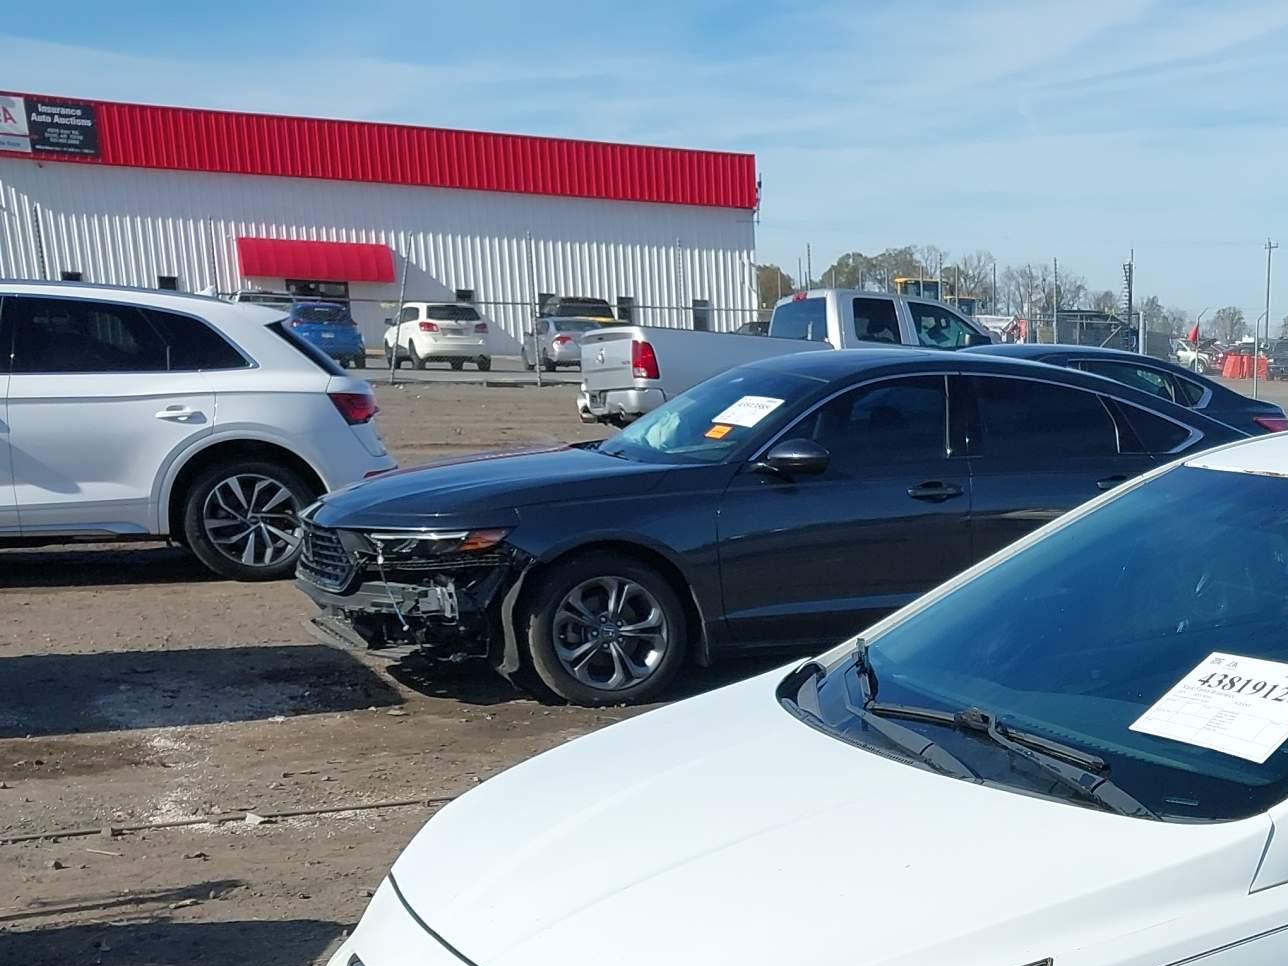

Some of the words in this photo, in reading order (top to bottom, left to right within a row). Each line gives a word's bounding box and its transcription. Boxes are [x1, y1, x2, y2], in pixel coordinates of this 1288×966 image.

[38, 104, 82, 116] Insurance
[31, 112, 51, 122] Auto
[53, 115, 92, 127] Auctions
